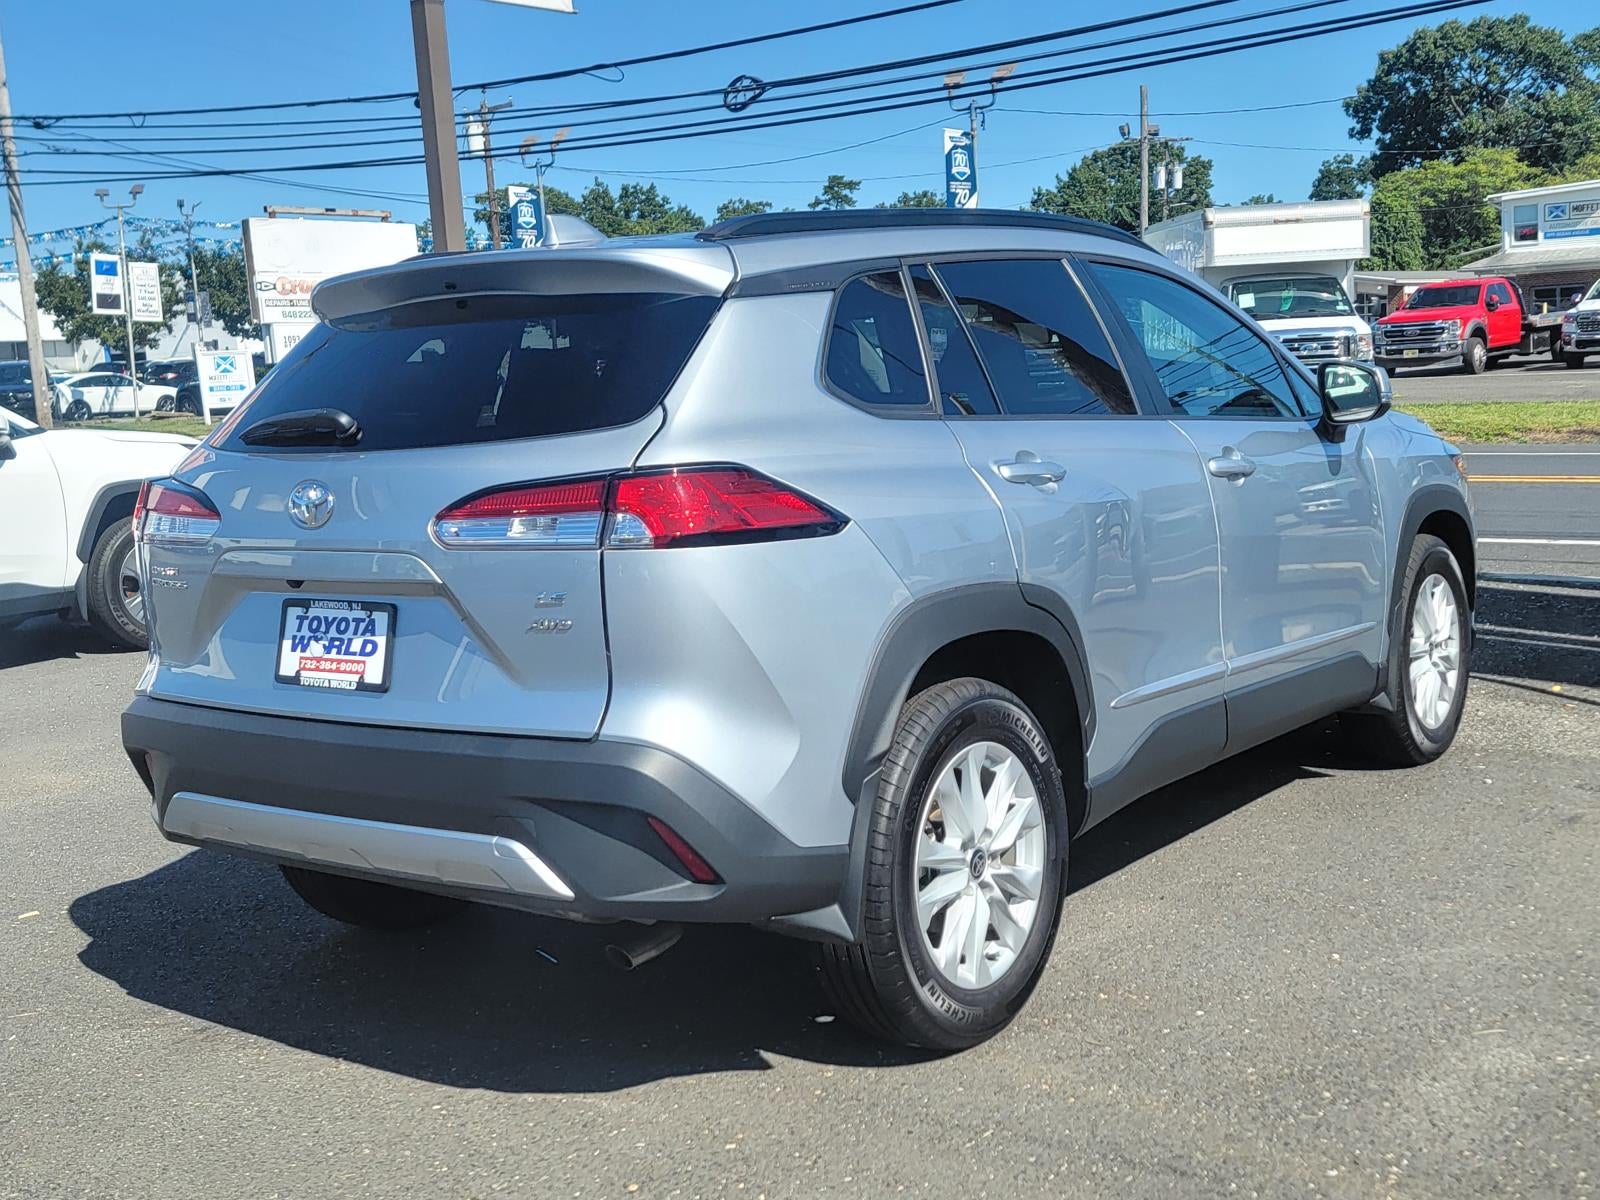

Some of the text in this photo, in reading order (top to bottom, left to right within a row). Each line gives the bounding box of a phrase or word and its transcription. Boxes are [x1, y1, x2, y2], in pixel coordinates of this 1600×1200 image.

[352, 602, 362, 611] NJ
[295, 614, 376, 636] TOYOTA
[300, 677, 357, 690] TOYOTA WORLD
[1001, 711, 1047, 758] MICHELIN
